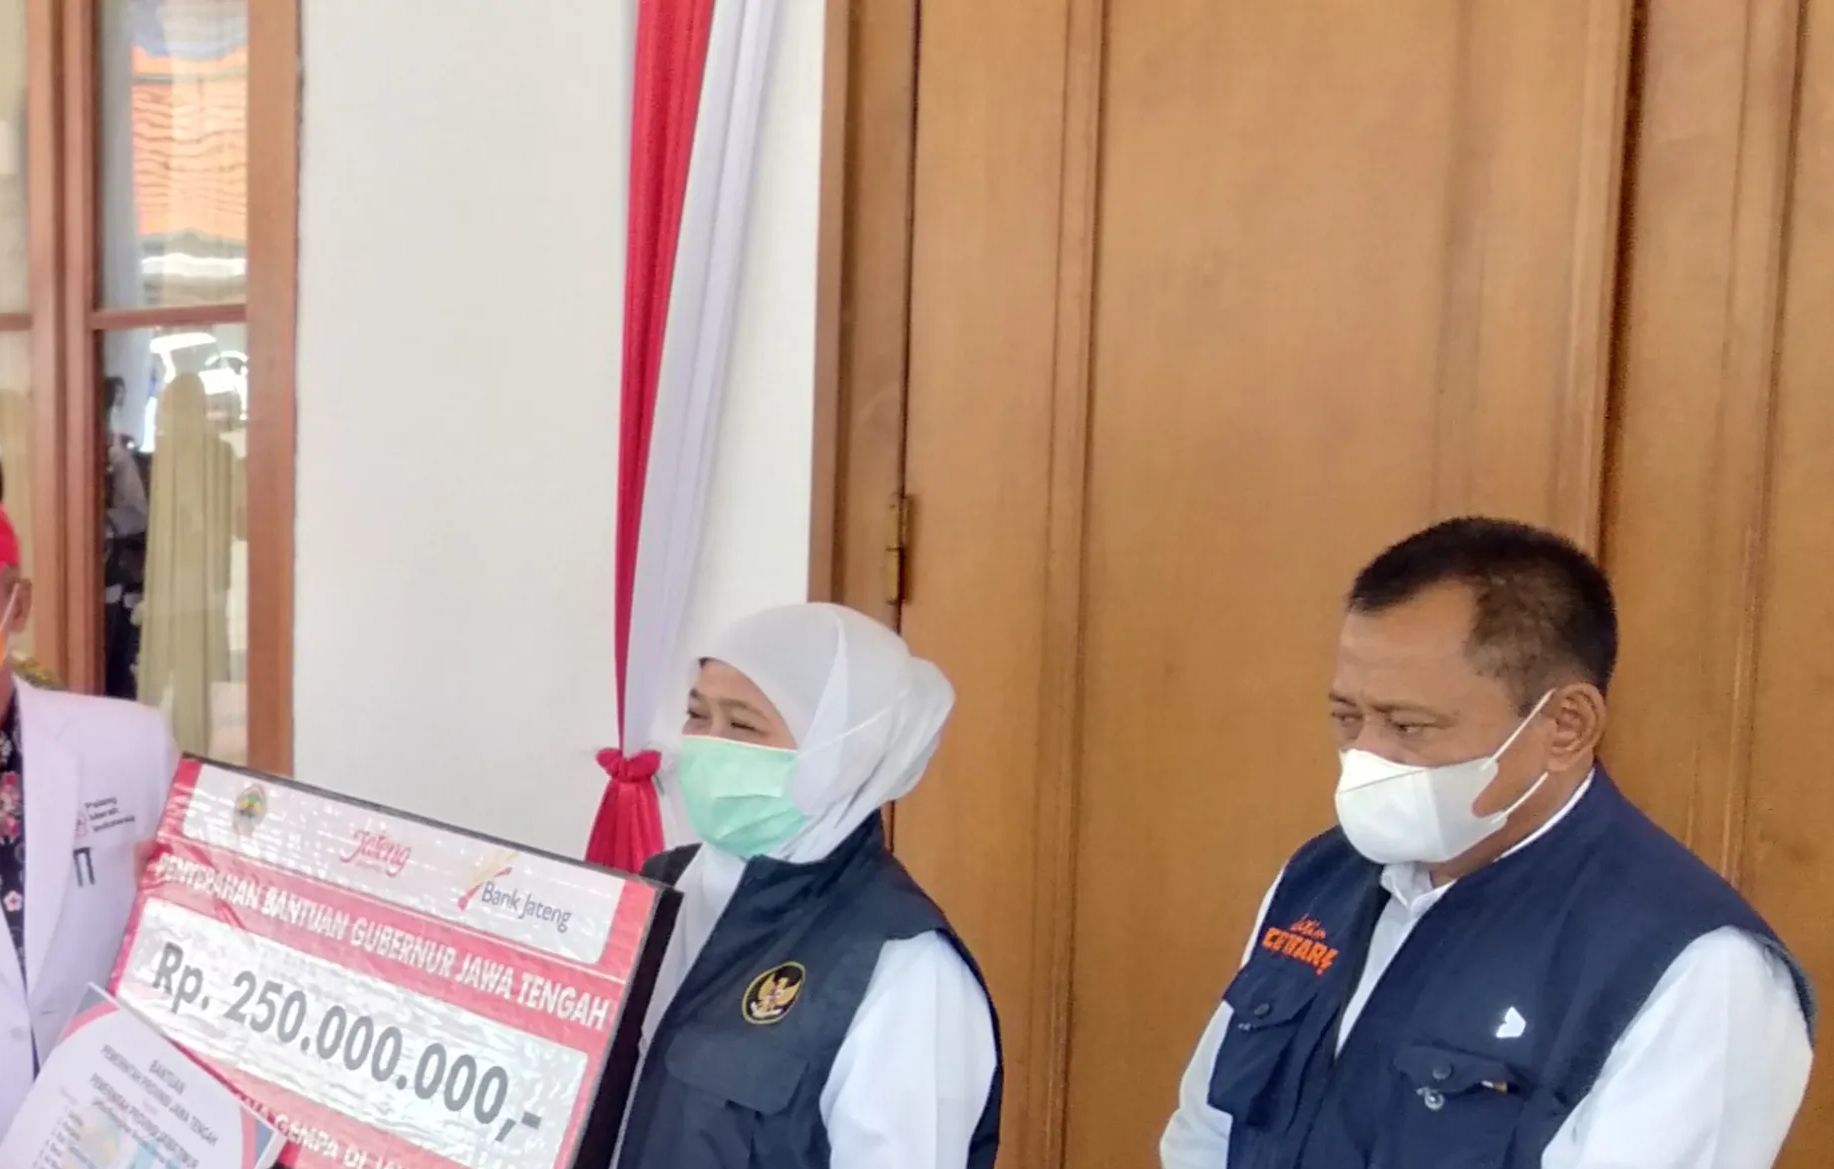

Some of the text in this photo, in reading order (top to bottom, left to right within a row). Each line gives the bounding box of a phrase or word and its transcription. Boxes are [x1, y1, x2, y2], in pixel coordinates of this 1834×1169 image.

[339, 829, 411, 877] Jateng
[481, 881, 572, 933] Bank Jateng
[263, 886, 348, 941] BANTUAN
[351, 915, 458, 979] GUBERNUR
[455, 952, 513, 1001] JAWA
[517, 972, 611, 1031] TENGAH
[152, 941, 210, 1014] Rp.
[222, 969, 543, 1143] 250.000.000,-
